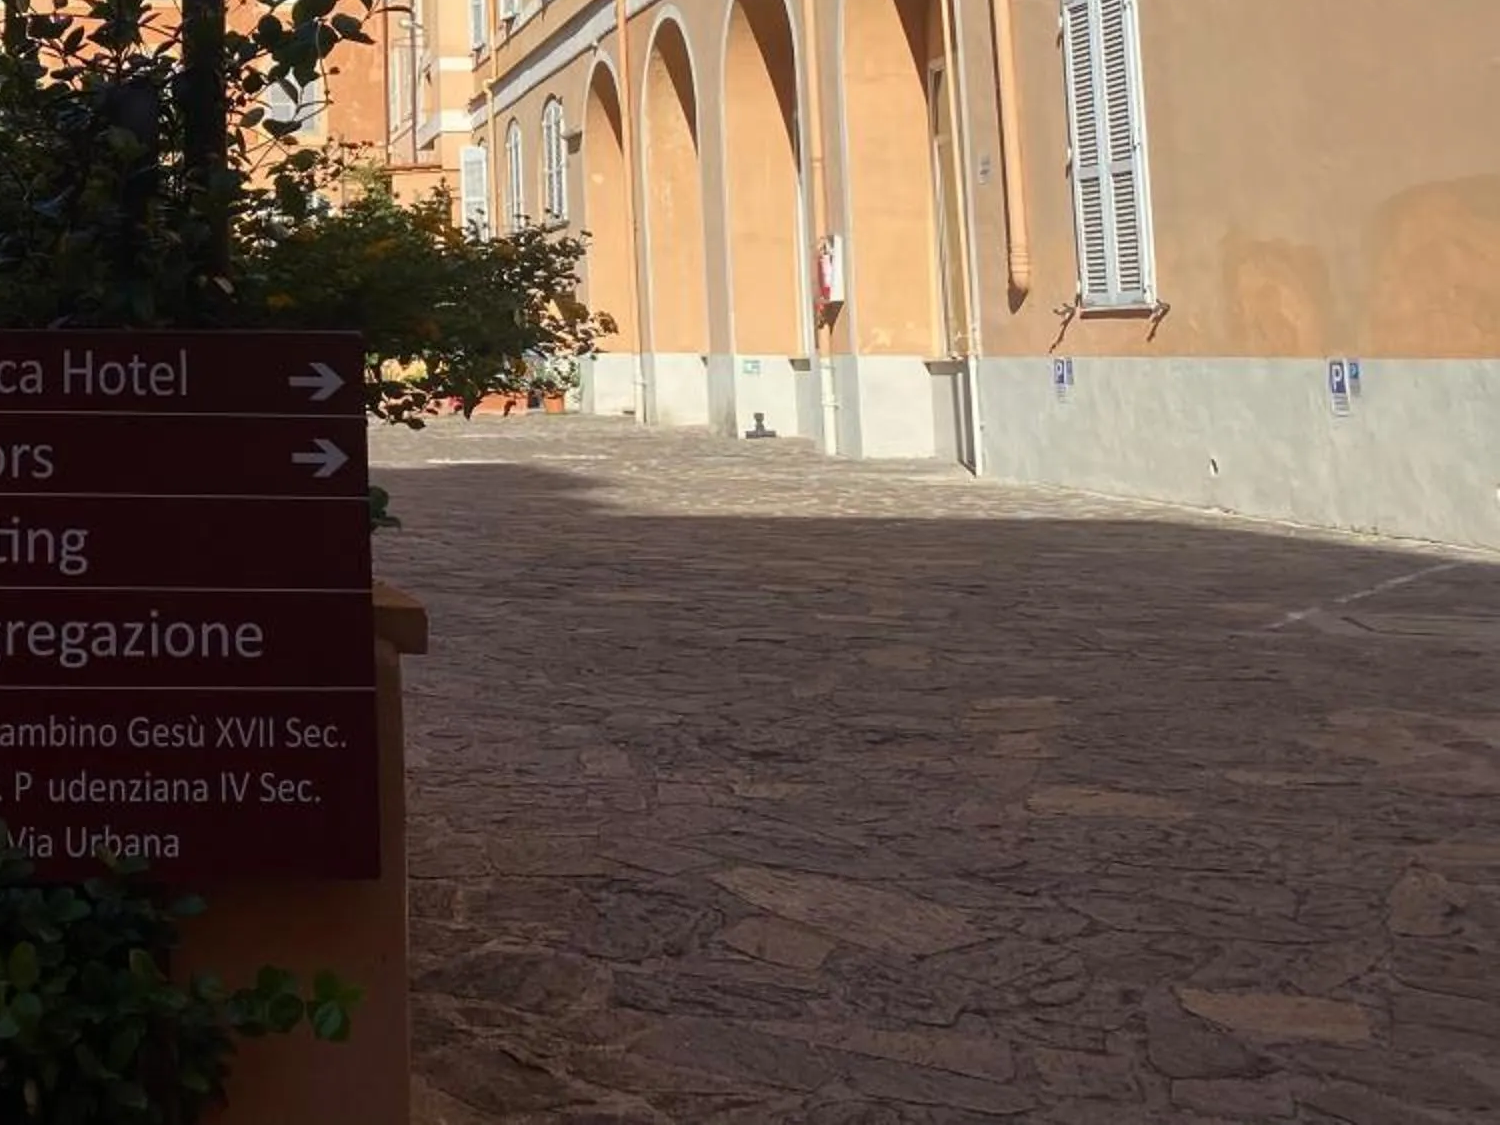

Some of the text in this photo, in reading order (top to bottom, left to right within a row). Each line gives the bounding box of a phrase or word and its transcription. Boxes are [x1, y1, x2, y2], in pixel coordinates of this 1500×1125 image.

[63, 349, 188, 396] Hotel
[1331, 364, 1343, 391] P
[127, 715, 206, 749] Gesù
[216, 717, 275, 749] XVII
[285, 717, 349, 750] Sec.
[220, 772, 251, 803] IV
[260, 772, 323, 803] Sec.
[6, 826, 54, 857] Via
[65, 825, 181, 858] Urbana
